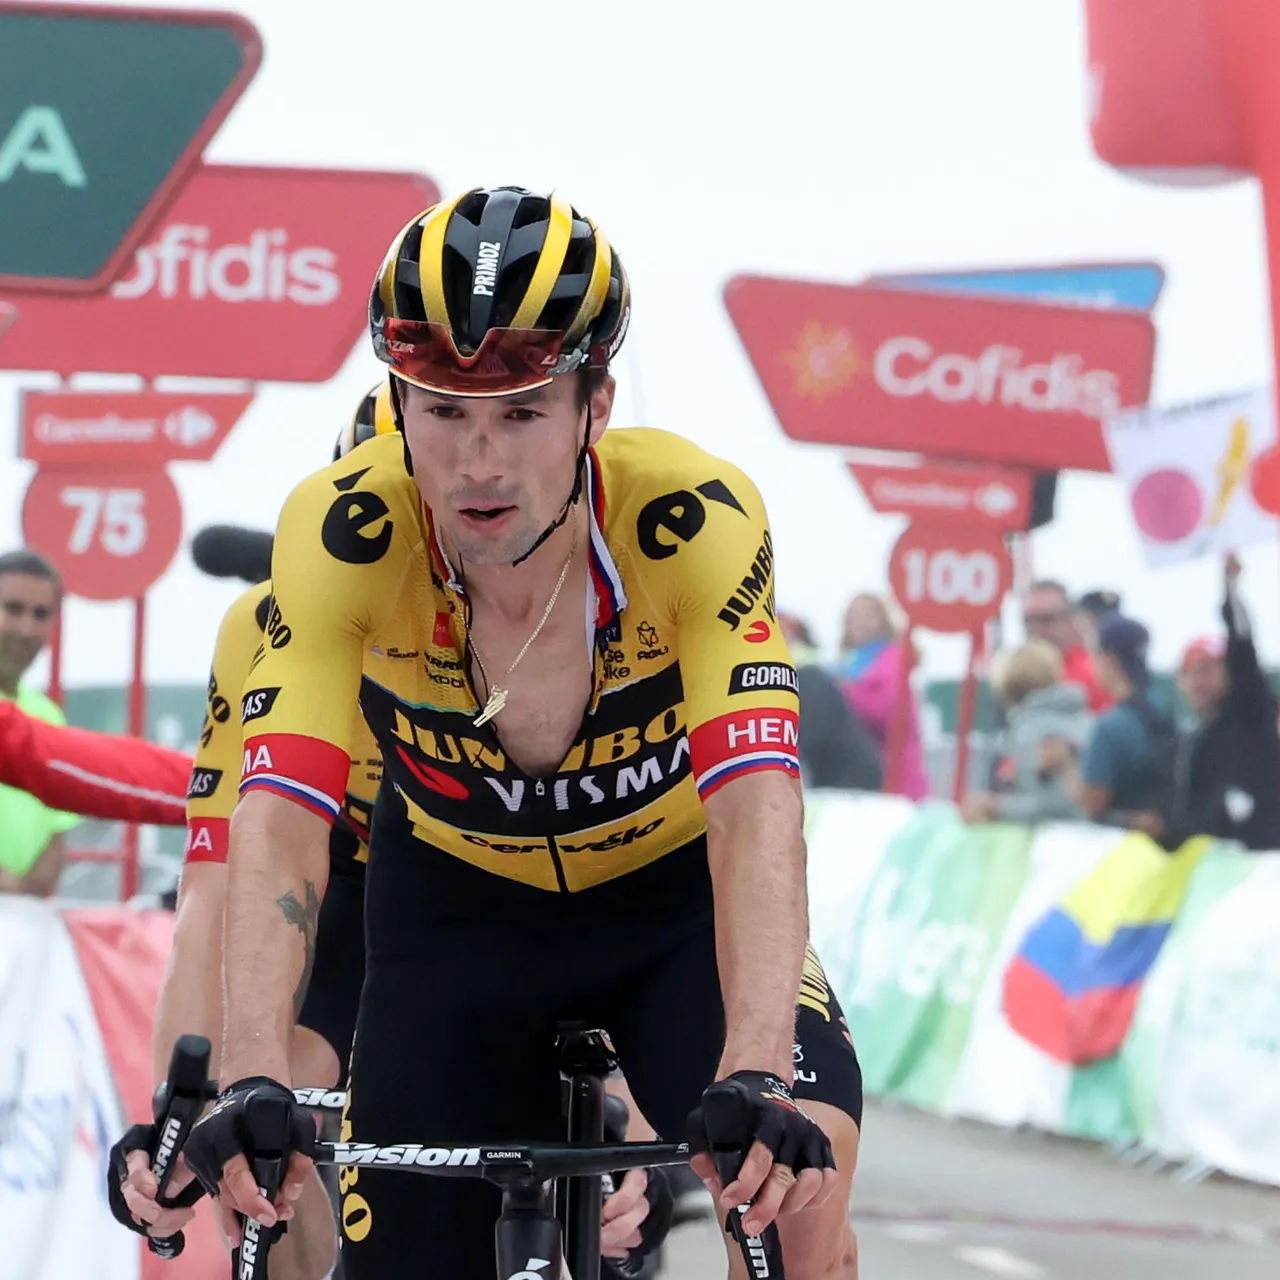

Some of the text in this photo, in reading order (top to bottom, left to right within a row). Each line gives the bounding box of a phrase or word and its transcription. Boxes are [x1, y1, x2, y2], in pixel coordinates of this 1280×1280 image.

[110, 224, 340, 305] ofidis
[872, 335, 1122, 416] Cofidis
[59, 488, 148, 557] 75
[901, 549, 1001, 605] 100
[727, 718, 800, 749] HEM
[321, 1141, 481, 1166] Vision
[486, 1151, 522, 1159] GARMIN
